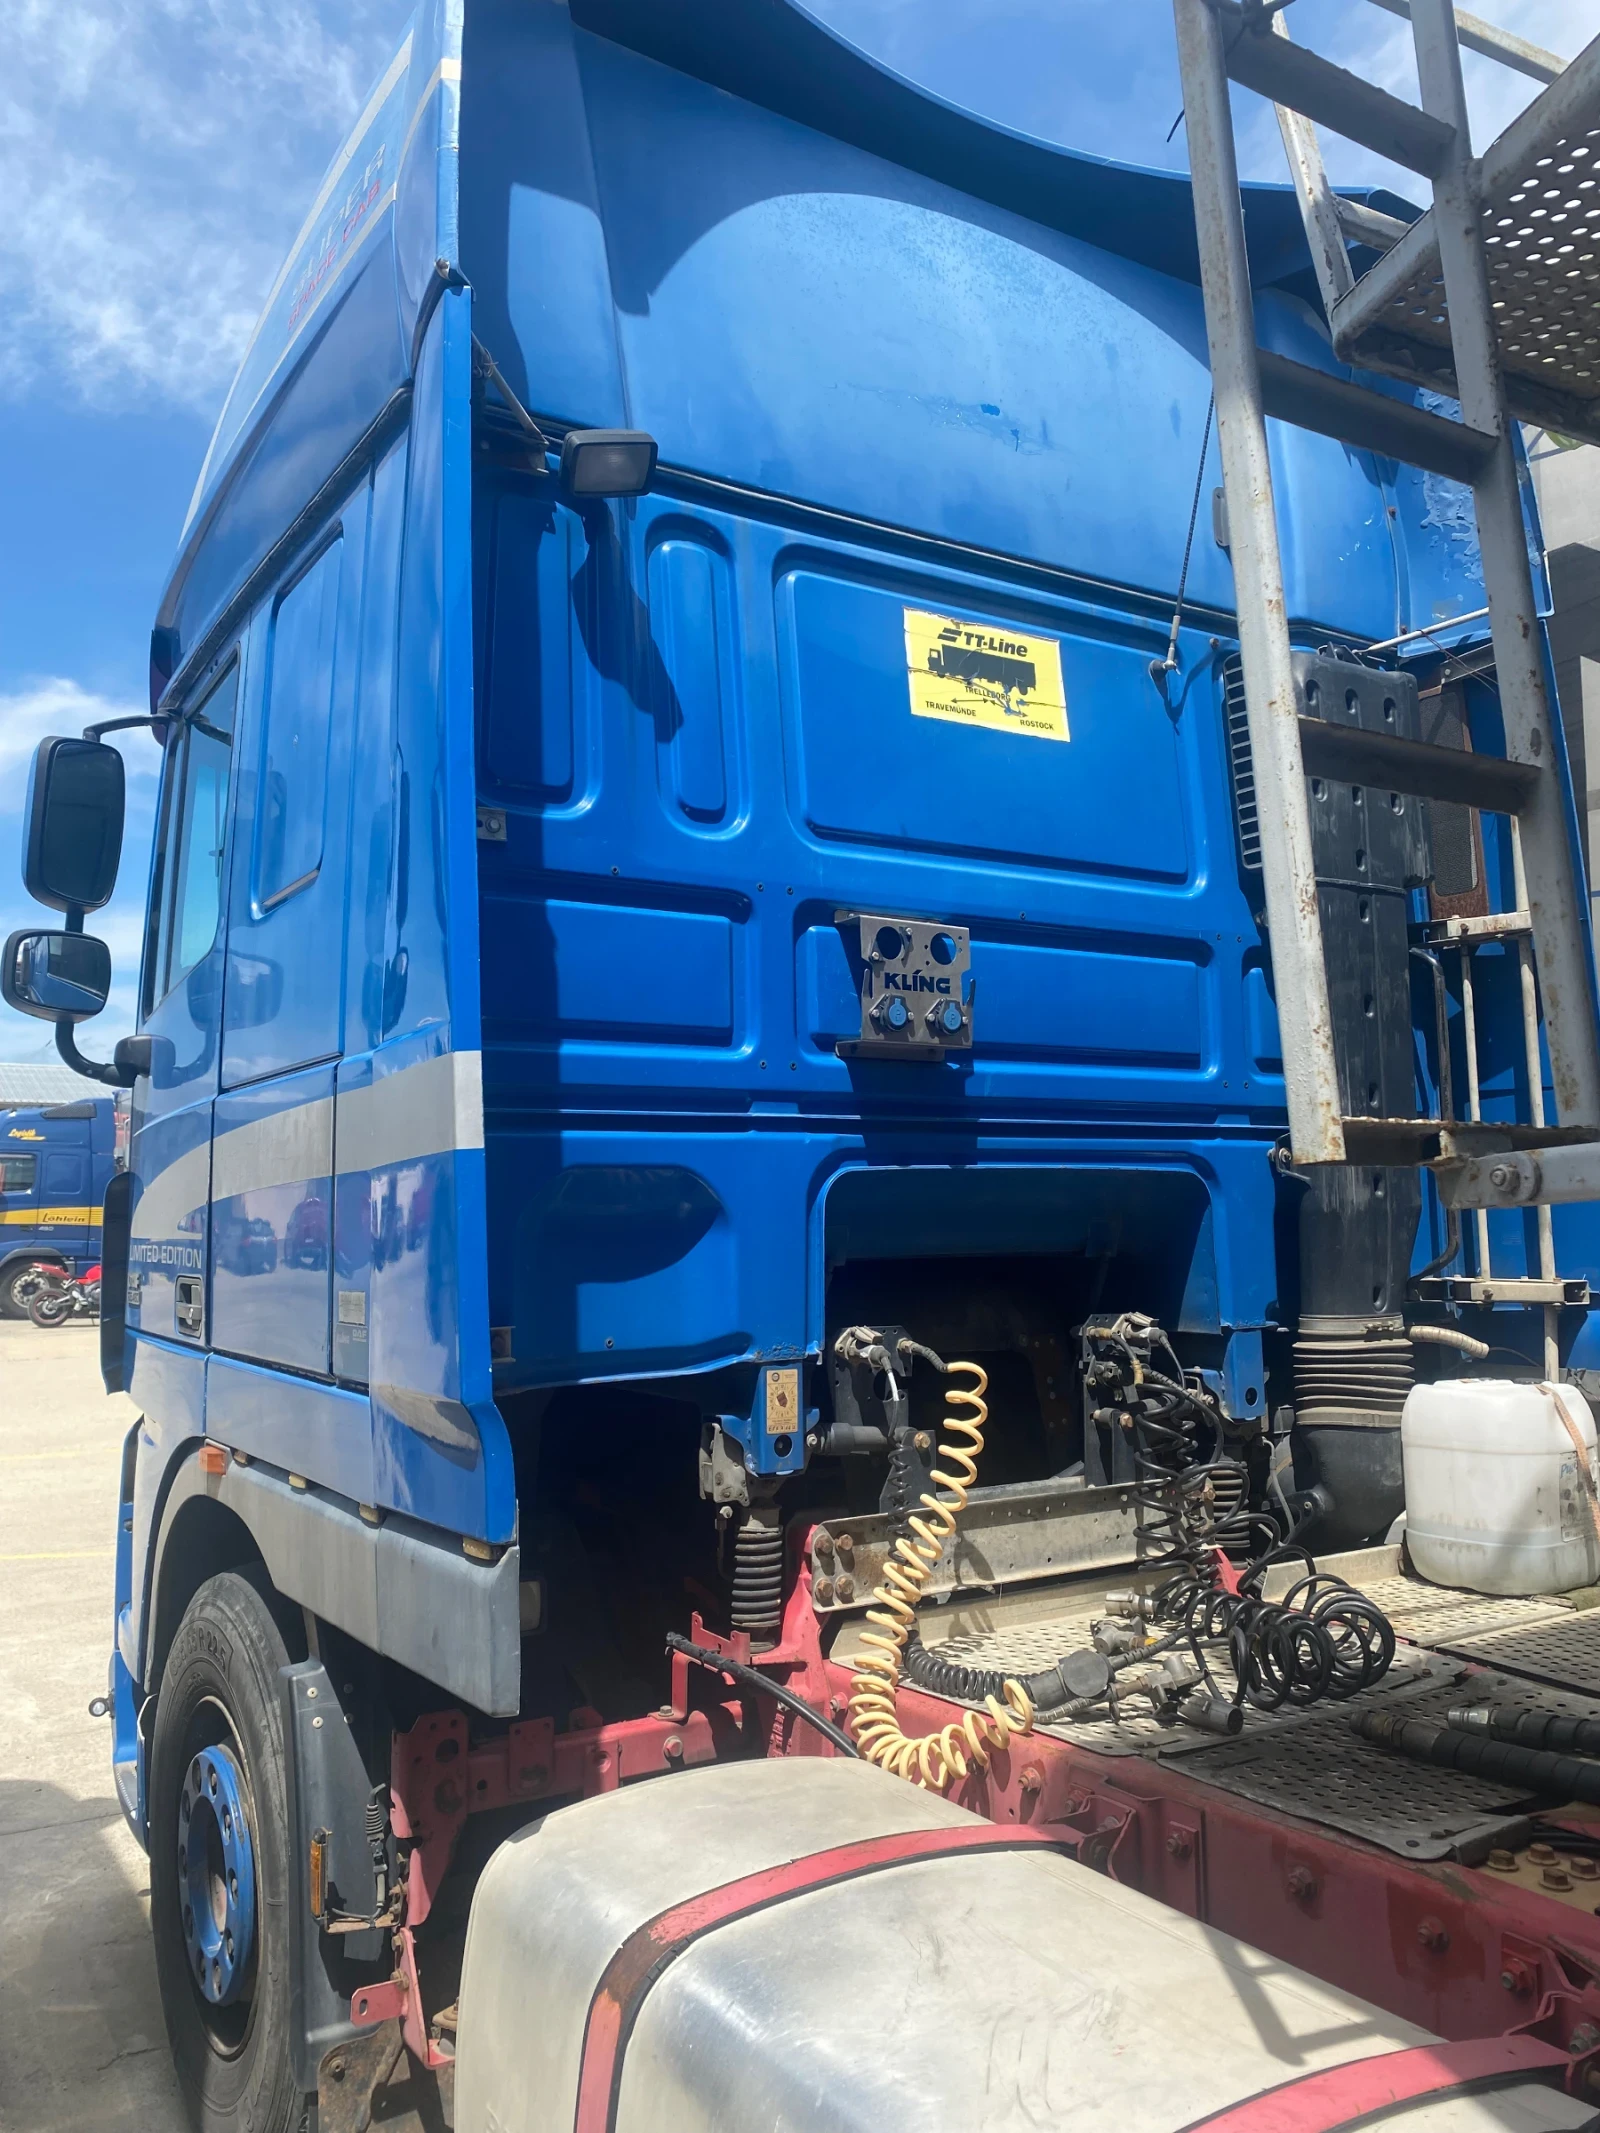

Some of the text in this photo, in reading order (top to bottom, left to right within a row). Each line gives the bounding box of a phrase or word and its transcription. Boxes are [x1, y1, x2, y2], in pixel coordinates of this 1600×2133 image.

[963, 631, 1028, 658] TT-Line
[1019, 719, 1055, 731] ROSTOCK
[130, 1244, 202, 1269] LIMITED EDITION
